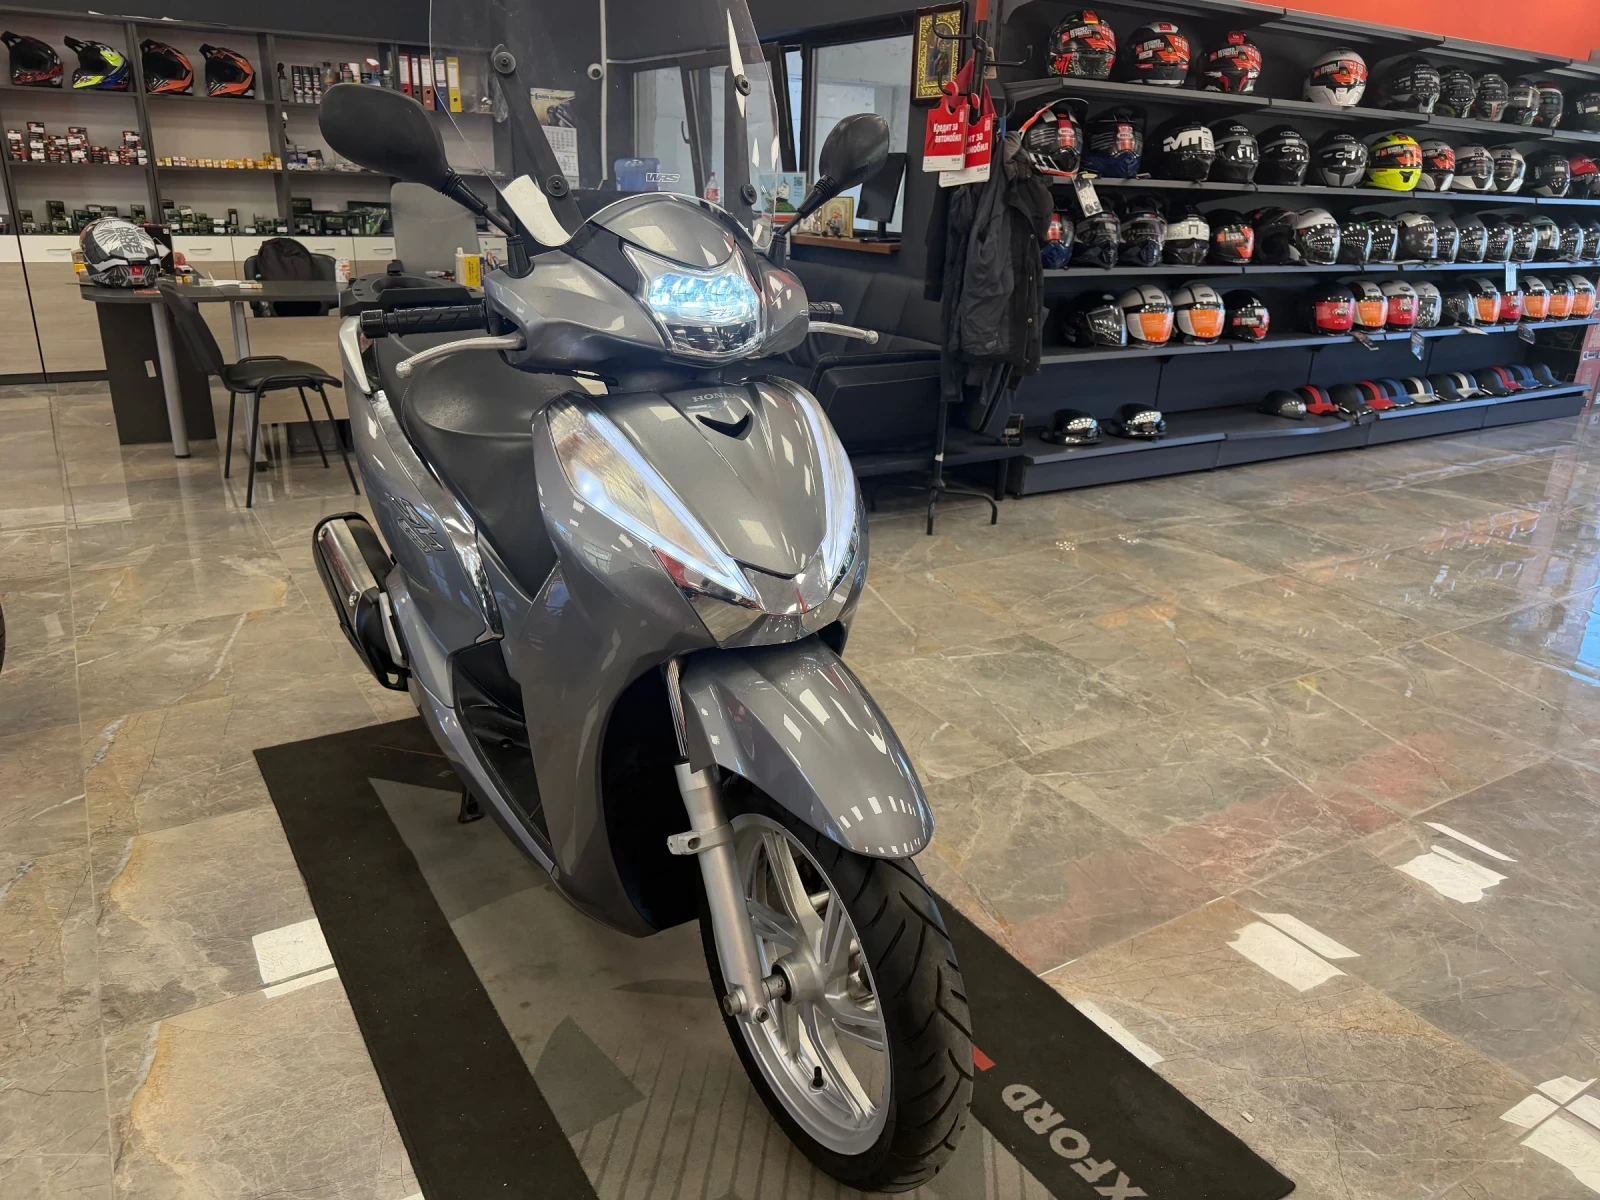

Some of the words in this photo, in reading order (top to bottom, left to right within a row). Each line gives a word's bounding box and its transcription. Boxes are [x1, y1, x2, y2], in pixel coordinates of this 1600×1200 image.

[933, 122, 952, 134] Кредит
[934, 132, 962, 143] автомобил
[645, 172, 681, 183] WRS
[691, 393, 740, 403] HONDA
